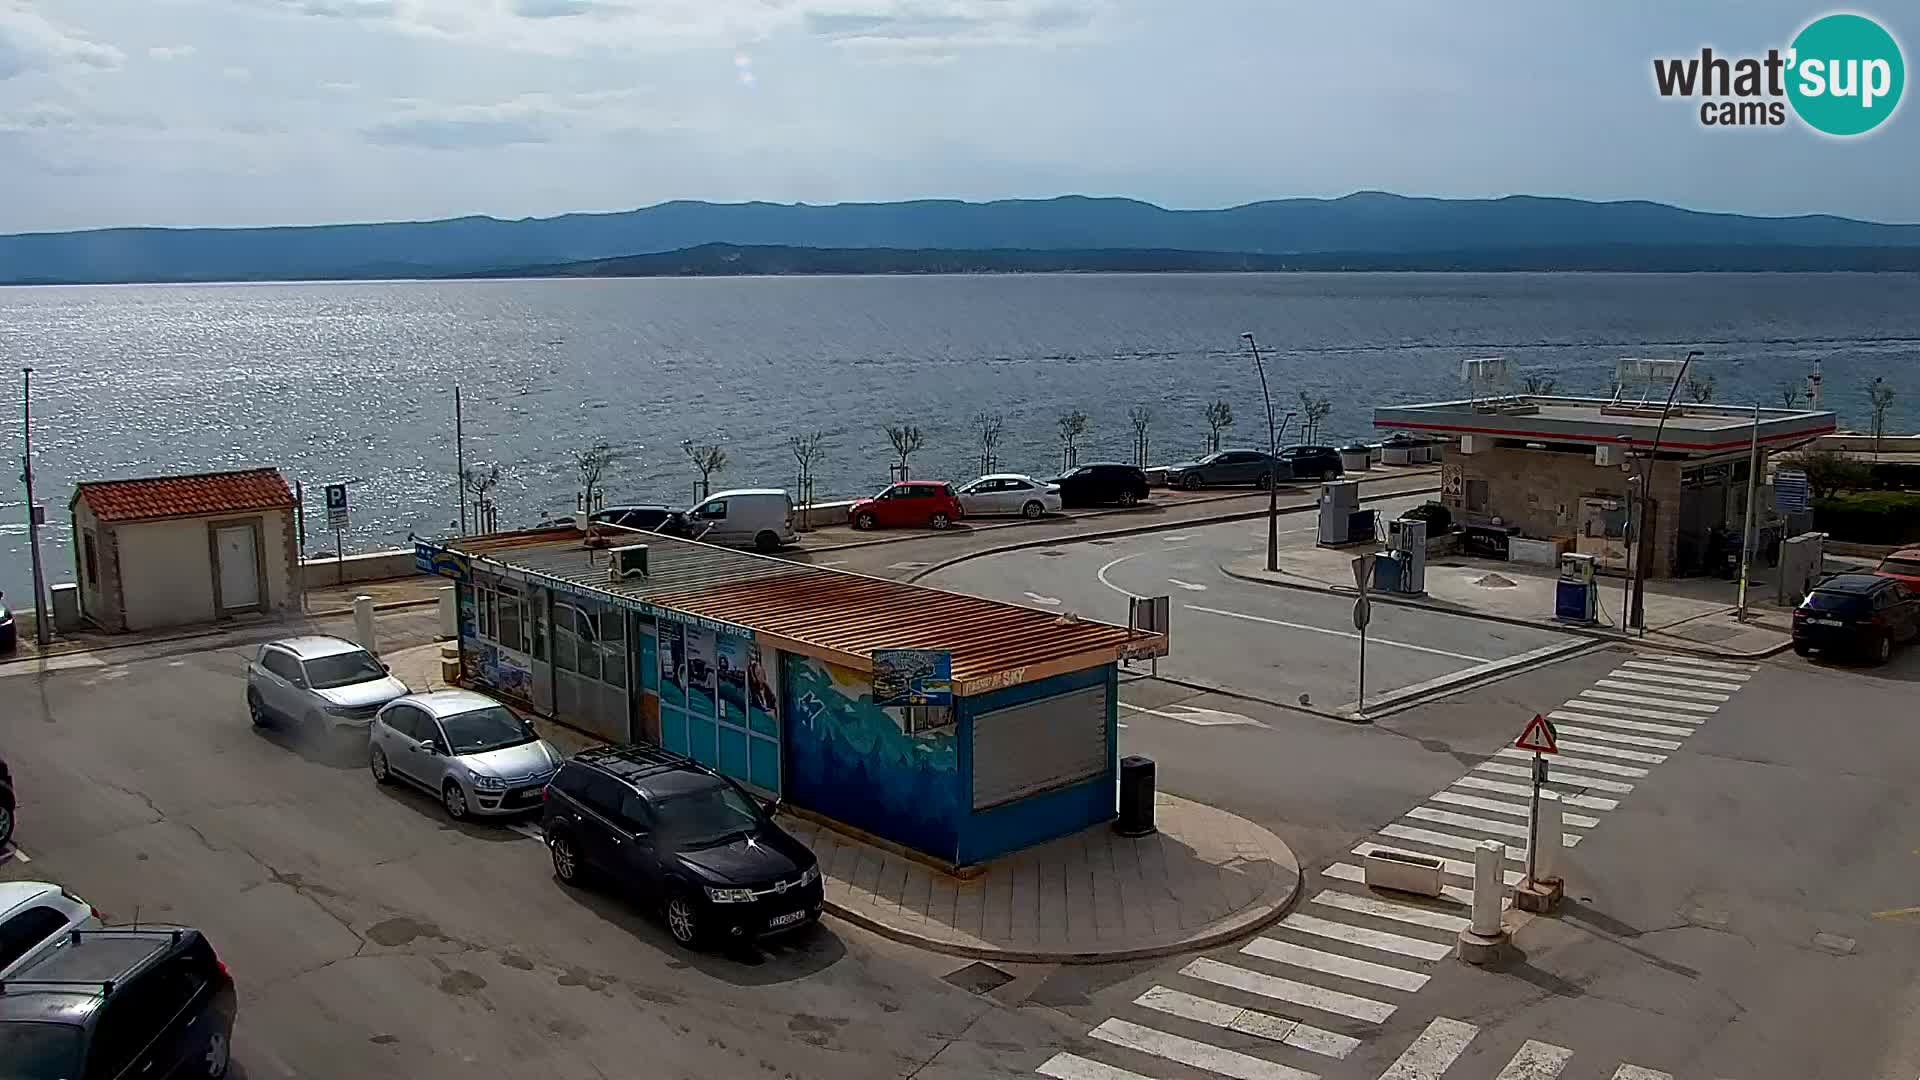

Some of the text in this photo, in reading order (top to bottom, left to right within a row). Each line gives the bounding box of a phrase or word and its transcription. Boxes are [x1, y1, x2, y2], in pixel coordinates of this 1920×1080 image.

[331, 488, 342, 505] P
[699, 619, 724, 633] TICKET
[725, 625, 752, 640] OFFICE
